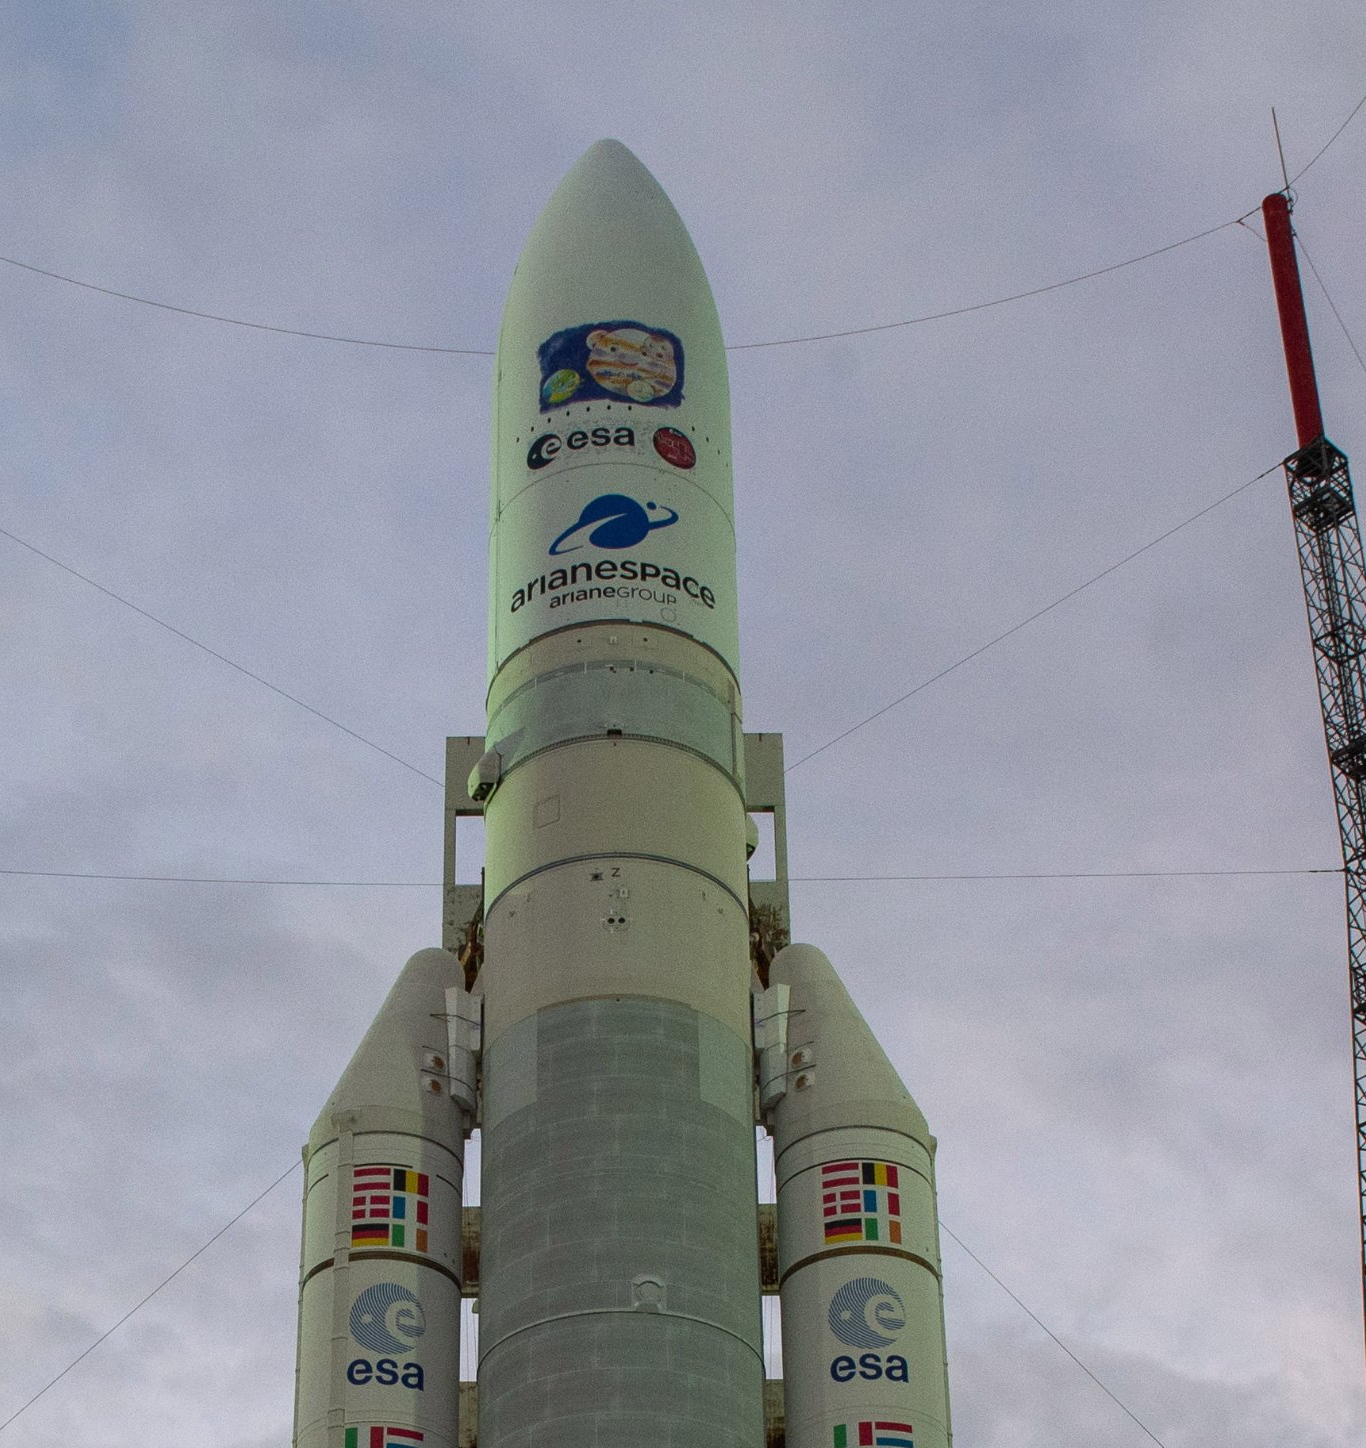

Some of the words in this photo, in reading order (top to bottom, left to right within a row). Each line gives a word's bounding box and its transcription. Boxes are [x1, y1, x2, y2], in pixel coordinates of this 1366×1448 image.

[565, 426, 636, 451] esa
[510, 559, 716, 613] arianespace
[346, 1357, 425, 1392] esa
[829, 1352, 910, 1384] esa
